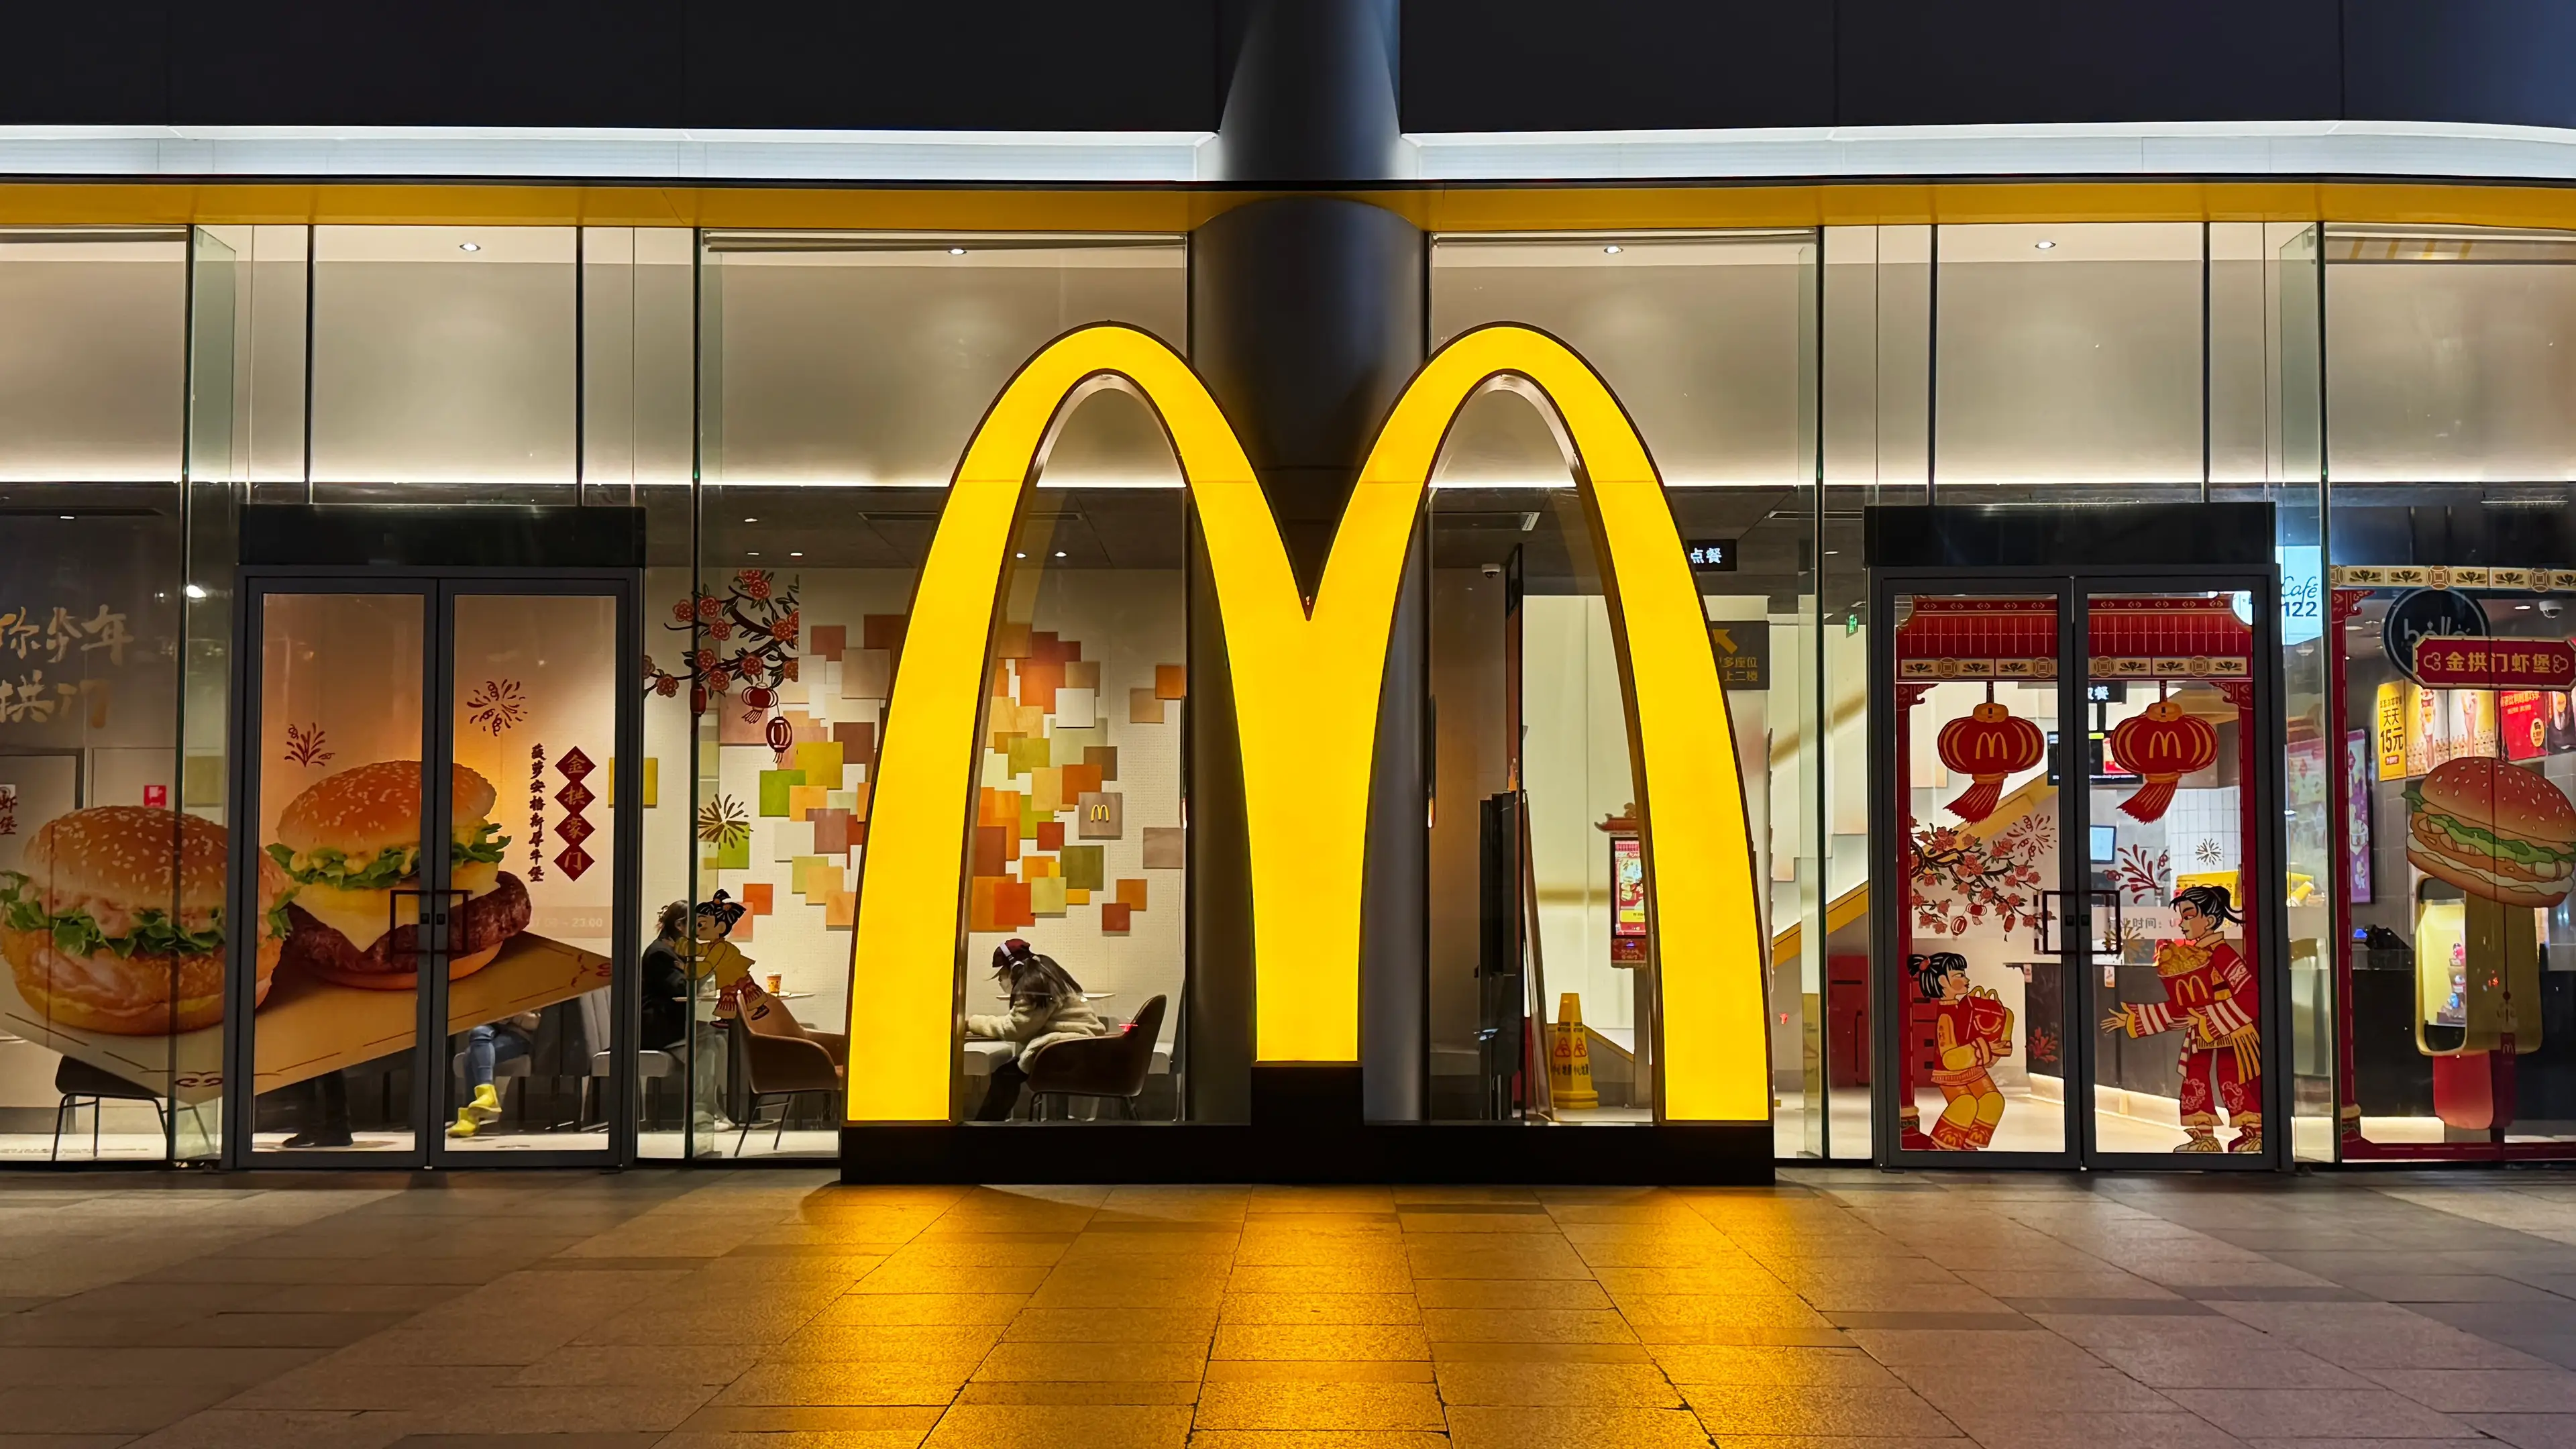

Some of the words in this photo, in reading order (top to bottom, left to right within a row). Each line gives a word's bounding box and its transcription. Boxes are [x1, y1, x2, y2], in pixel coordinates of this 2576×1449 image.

[1690, 547, 1723, 564] 点餐
[1720, 656, 1758, 668] 多座位
[2445, 651, 2551, 673] 金拱门虾堡
[1724, 672, 1758, 682] 上二楼
[2383, 708, 2400, 727] 天天
[2380, 727, 2404, 754] 15元
